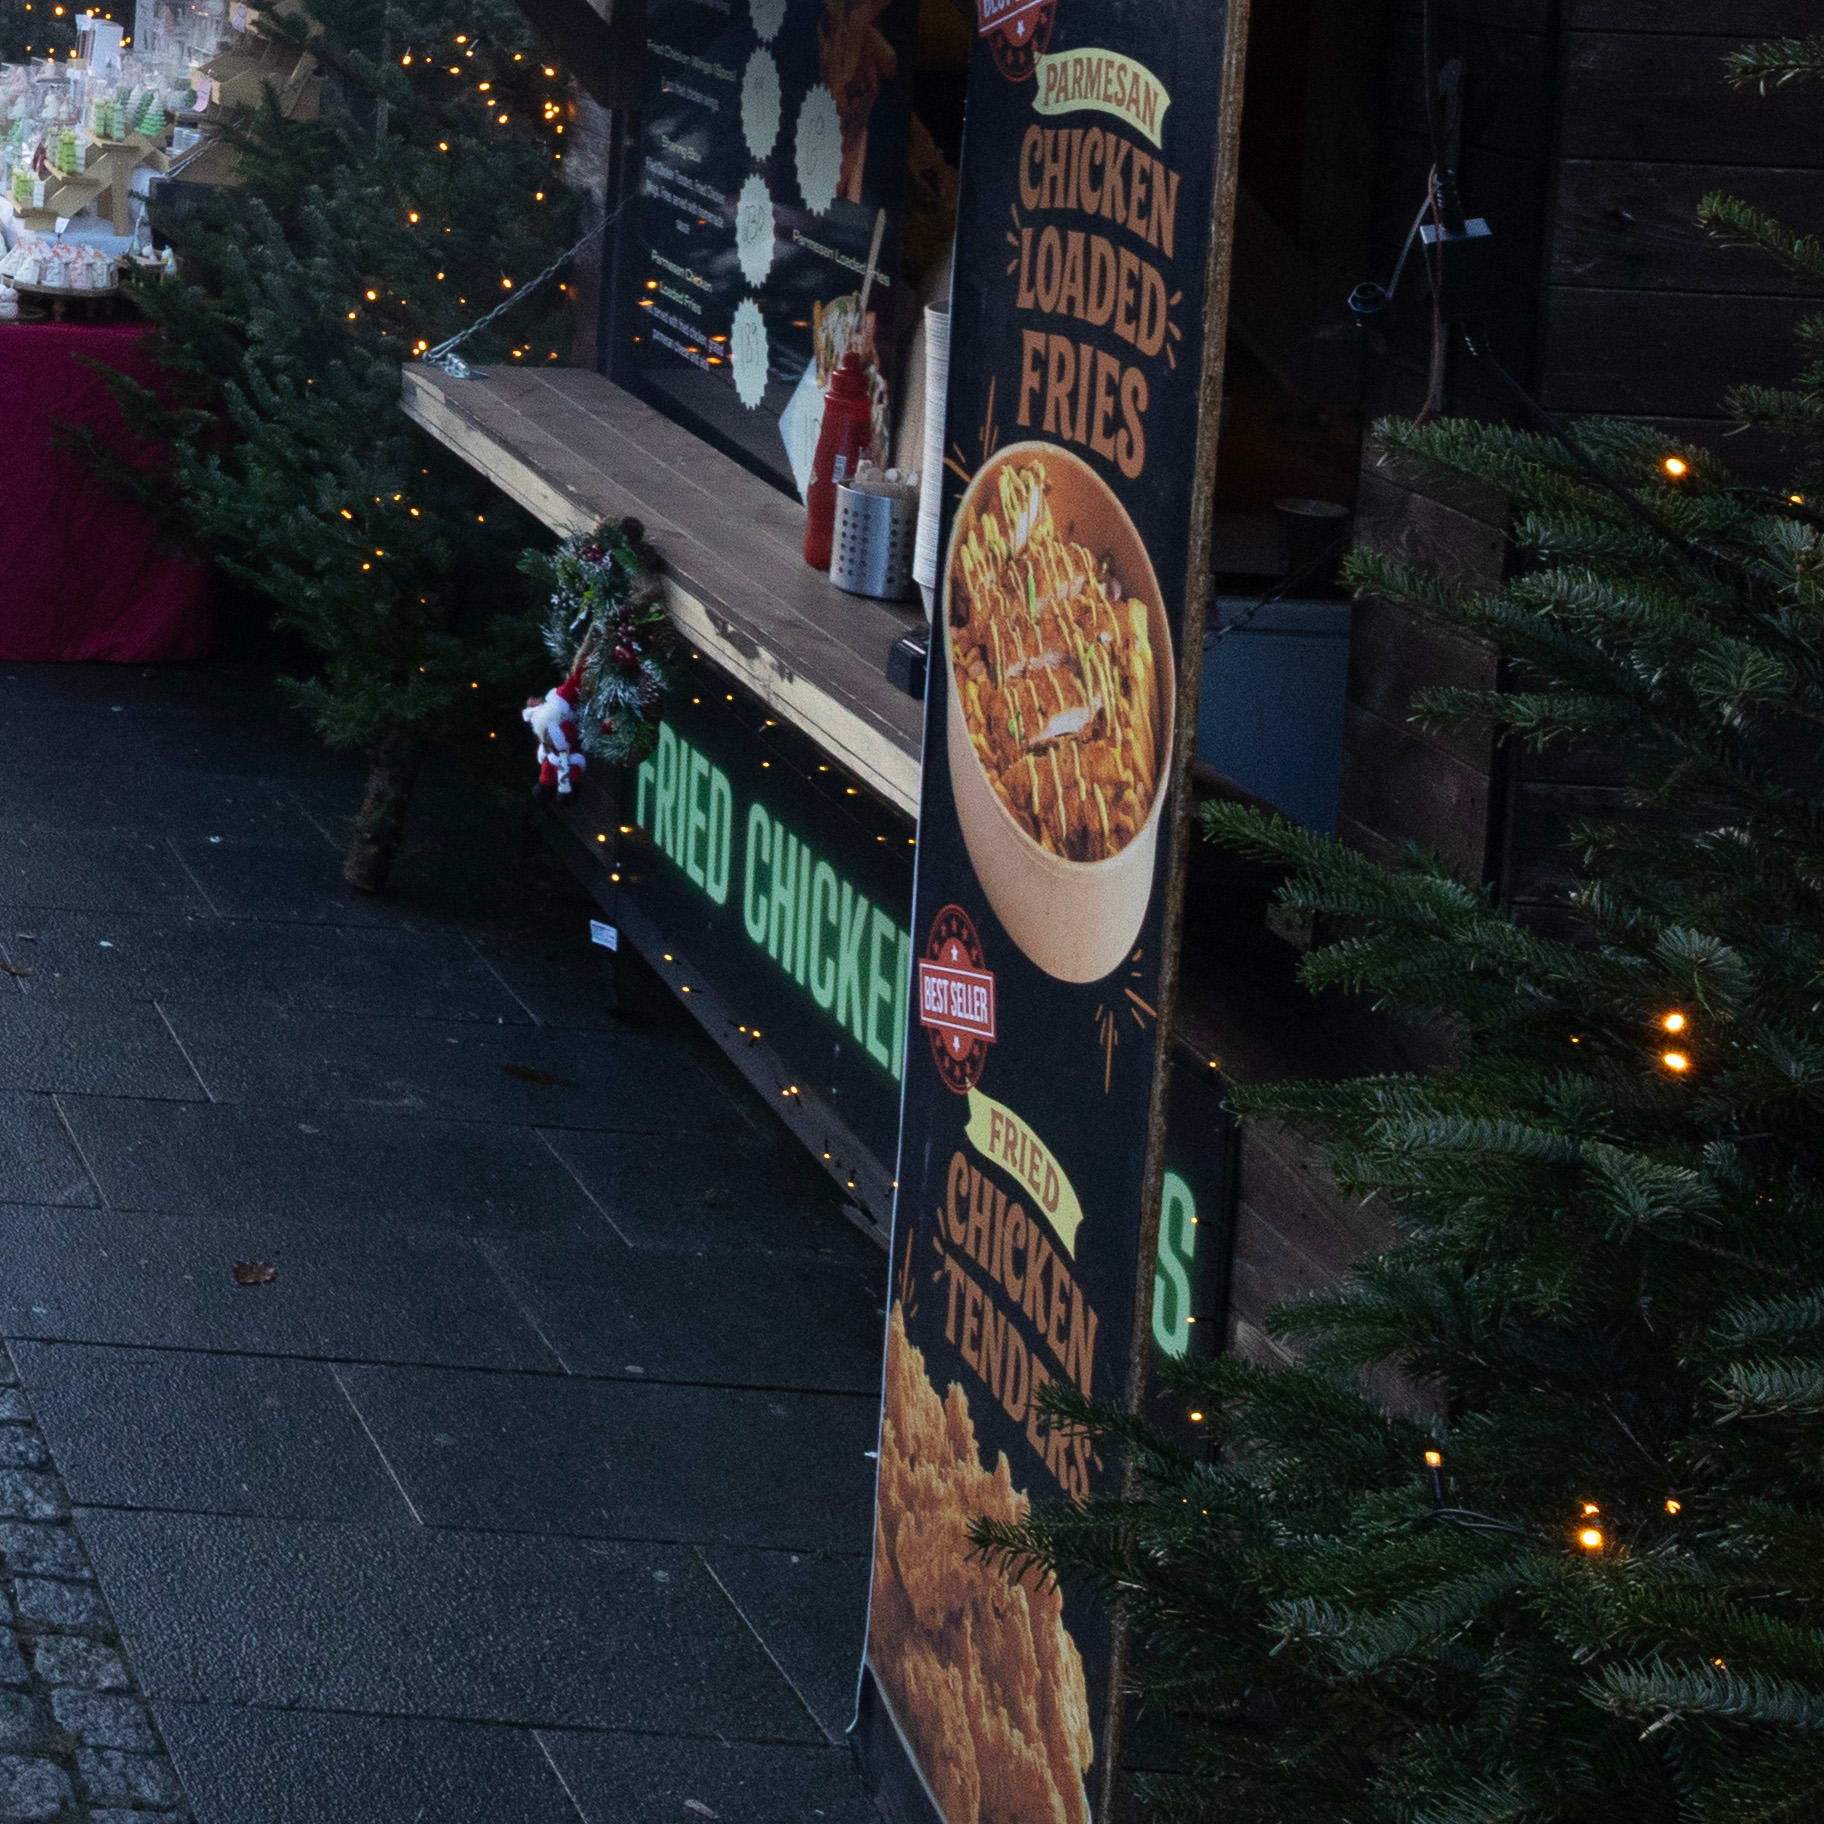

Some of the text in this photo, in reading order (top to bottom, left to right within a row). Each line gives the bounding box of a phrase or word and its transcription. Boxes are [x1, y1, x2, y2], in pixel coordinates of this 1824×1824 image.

[1043, 56, 1158, 130] PARMESAN
[1019, 124, 1180, 259] CHICKEN
[1016, 225, 1167, 356] LOADED
[1016, 330, 1149, 479] FRIES
[923, 974, 989, 1024] BEST SELLER
[989, 1106, 1061, 1214] FRIED
[946, 1149, 1099, 1398] CHICKEN
